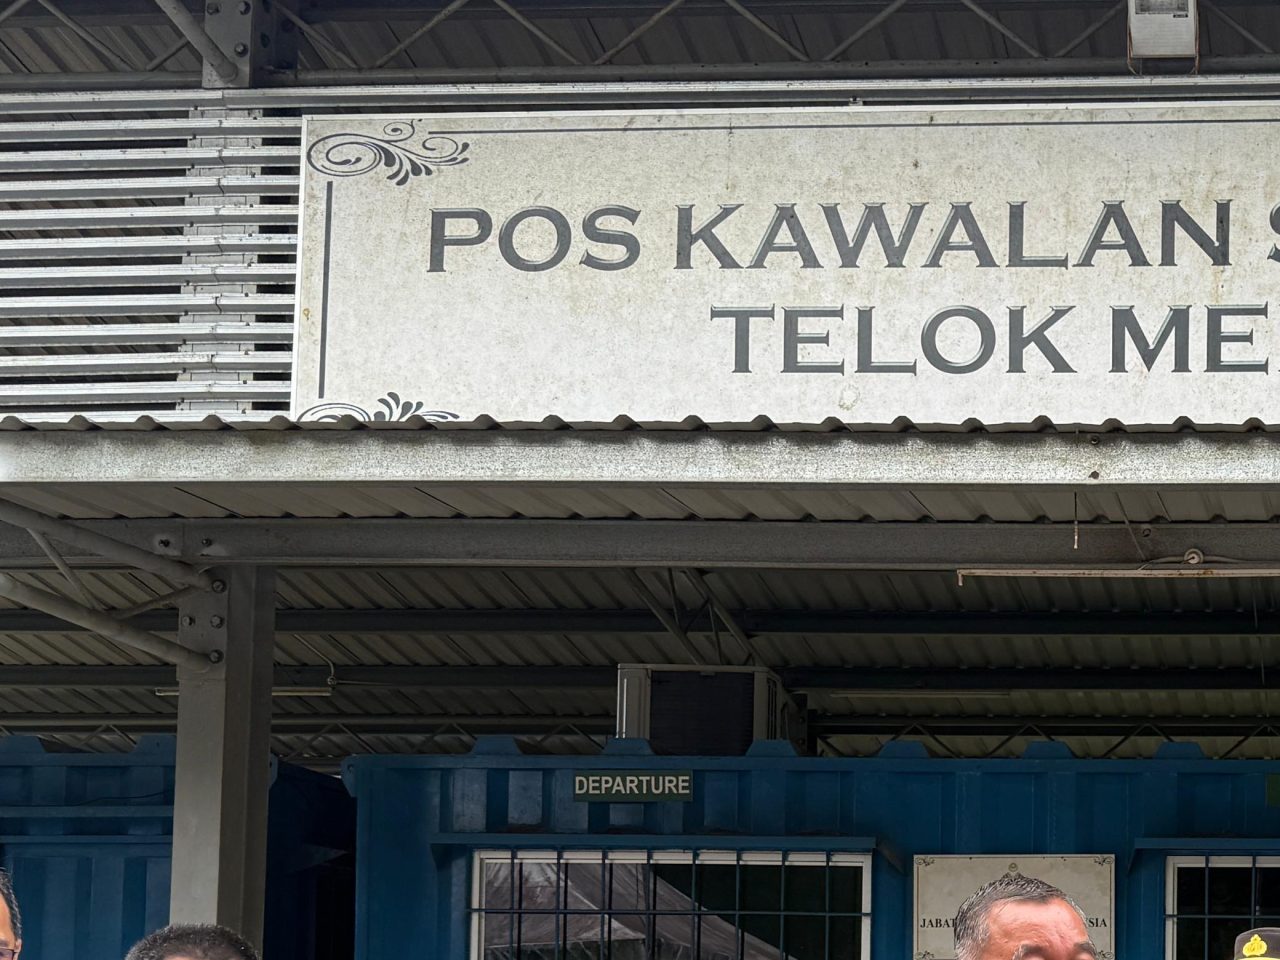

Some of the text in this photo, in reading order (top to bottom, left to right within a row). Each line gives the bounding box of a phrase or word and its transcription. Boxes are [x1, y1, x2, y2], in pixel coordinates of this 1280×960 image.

[425, 202, 643, 274] POS
[674, 199, 1233, 271] KAWALAN
[709, 302, 1078, 377] TELOK
[575, 775, 690, 794] DEPARTURE
[920, 917, 957, 928] JABAT
